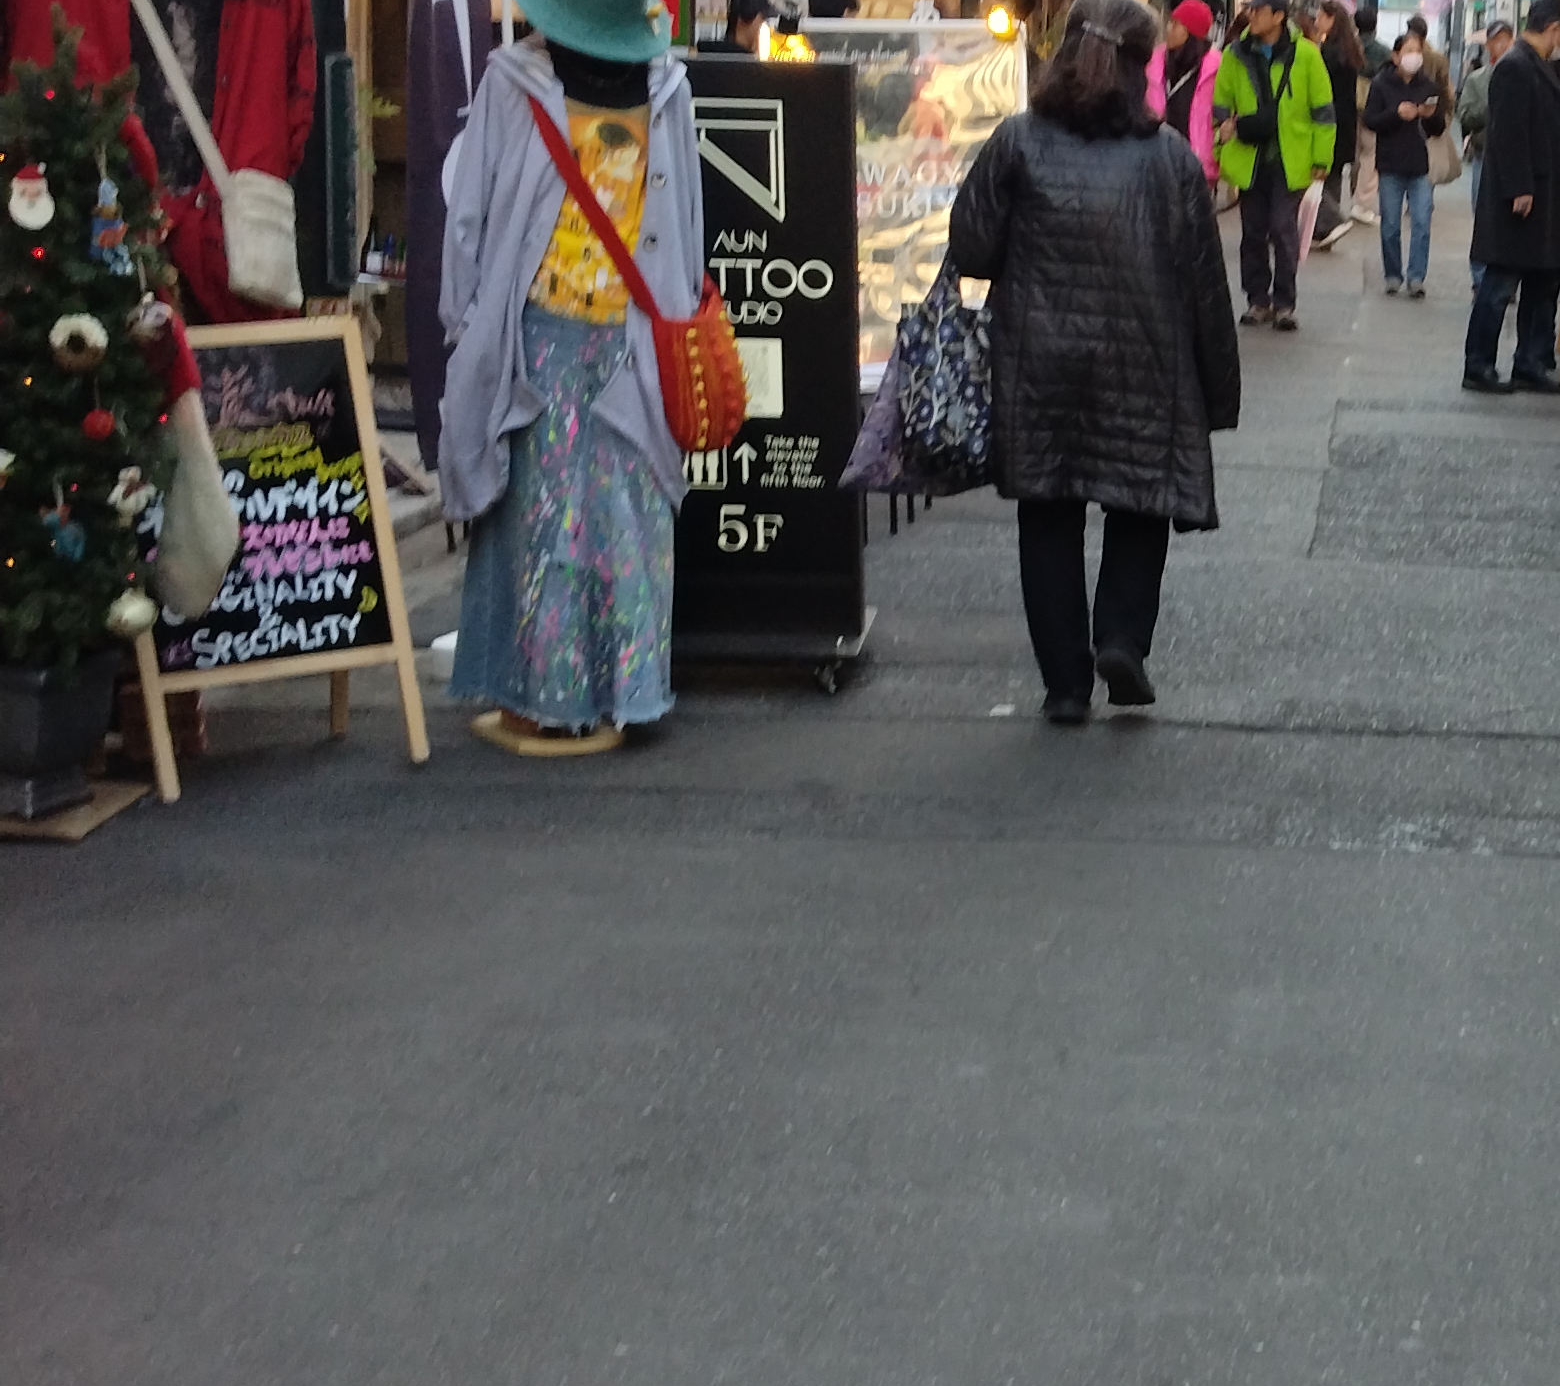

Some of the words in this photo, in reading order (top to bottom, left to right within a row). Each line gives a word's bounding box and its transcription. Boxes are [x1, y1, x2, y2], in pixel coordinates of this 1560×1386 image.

[713, 228, 768, 253] AUN
[764, 434, 795, 450] Take
[798, 434, 820, 450] the
[765, 449, 819, 463] elevator
[773, 461, 788, 474] to
[790, 461, 813, 474] the
[760, 473, 789, 488] fifth
[717, 503, 785, 553] 5F
[191, 612, 362, 669] SPECIALITY
